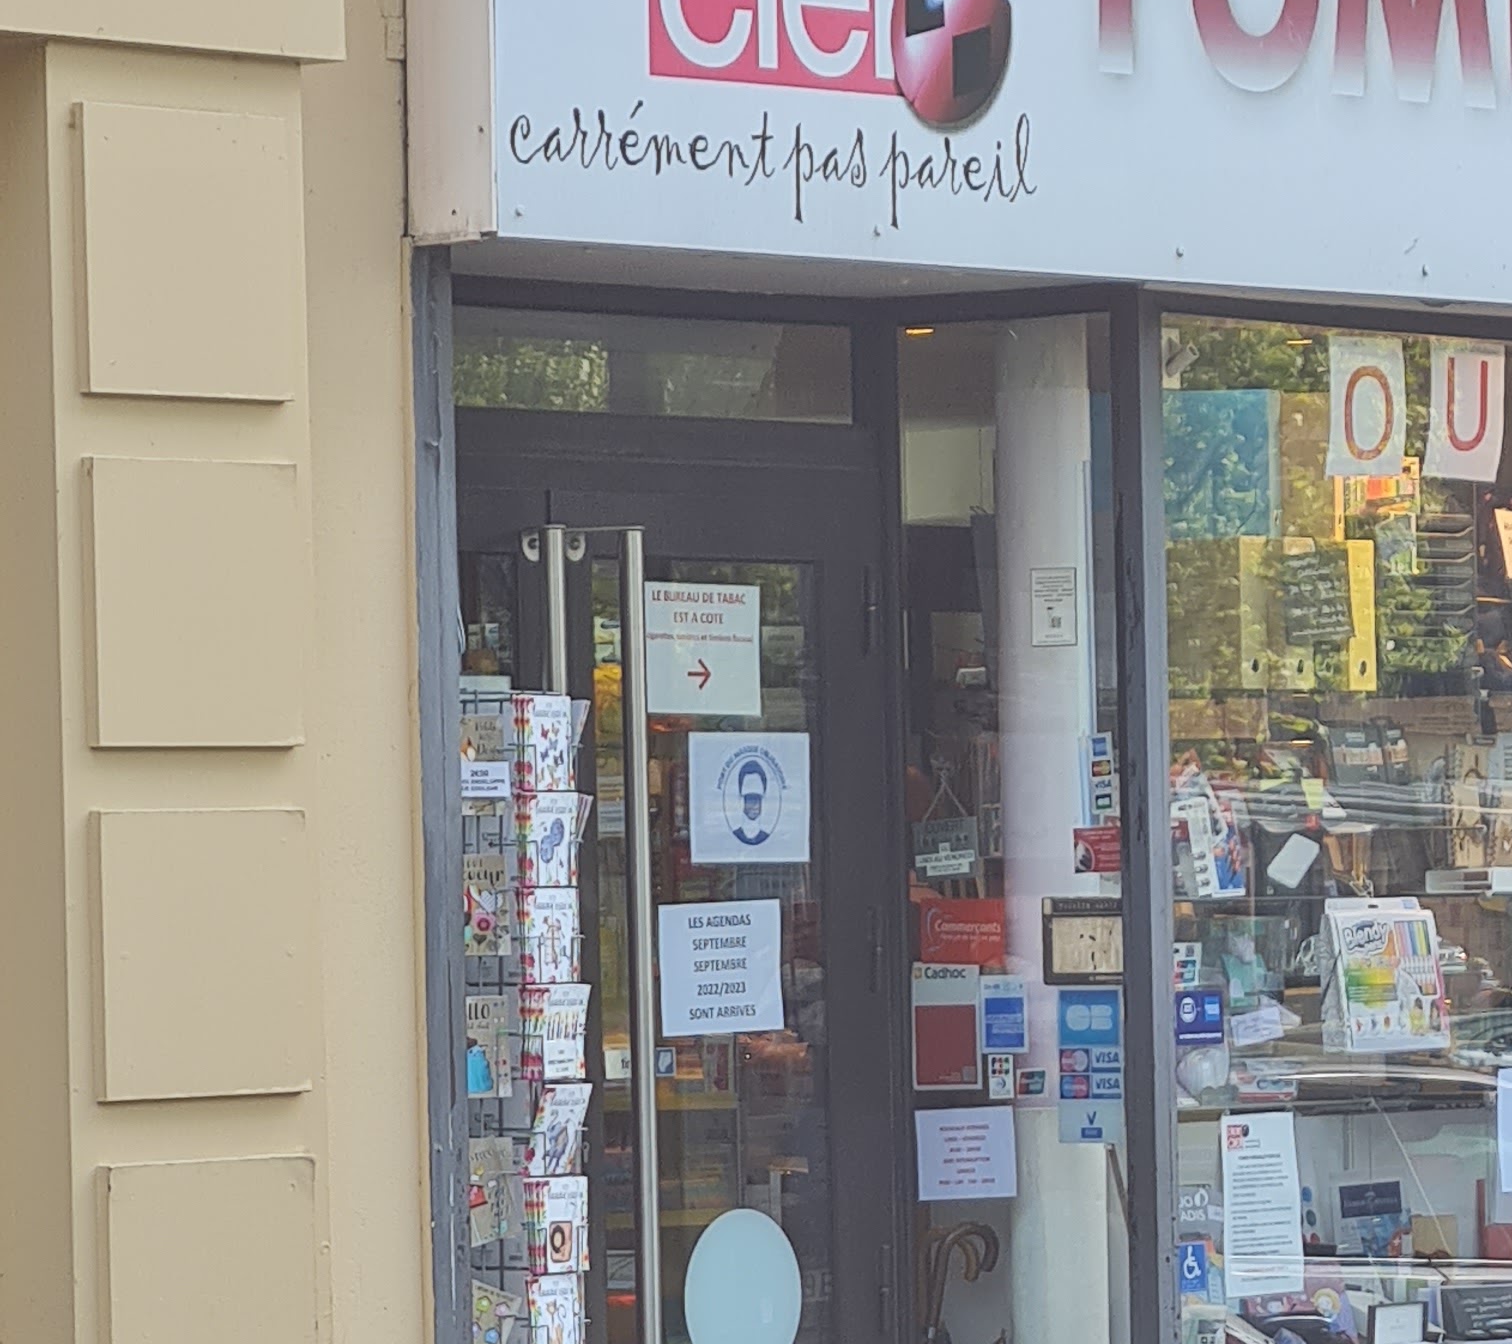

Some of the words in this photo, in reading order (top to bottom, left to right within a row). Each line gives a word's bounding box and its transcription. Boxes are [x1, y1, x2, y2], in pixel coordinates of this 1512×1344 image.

[507, 98, 775, 188] carrément
[784, 122, 868, 223] pas
[879, 111, 1039, 229] pareil
[651, 589, 661, 602] LE
[702, 592, 714, 604] DE
[717, 593, 746, 605] TABAC
[673, 611, 689, 624] EST
[687, 916, 704, 929] LES
[705, 913, 752, 928] AGENDAS
[692, 935, 748, 952] SEPTEMBRE
[693, 957, 748, 973] SEPTEMBRE
[924, 965, 967, 980] Cadhoc
[697, 981, 747, 997] 2022/2023
[688, 1006, 715, 1021] SONT
[716, 1003, 757, 1018] ARRIVES
[1094, 1050, 1120, 1065] VISA
[1094, 1077, 1121, 1090] VISA
[1180, 1209, 1207, 1222] ADIS
